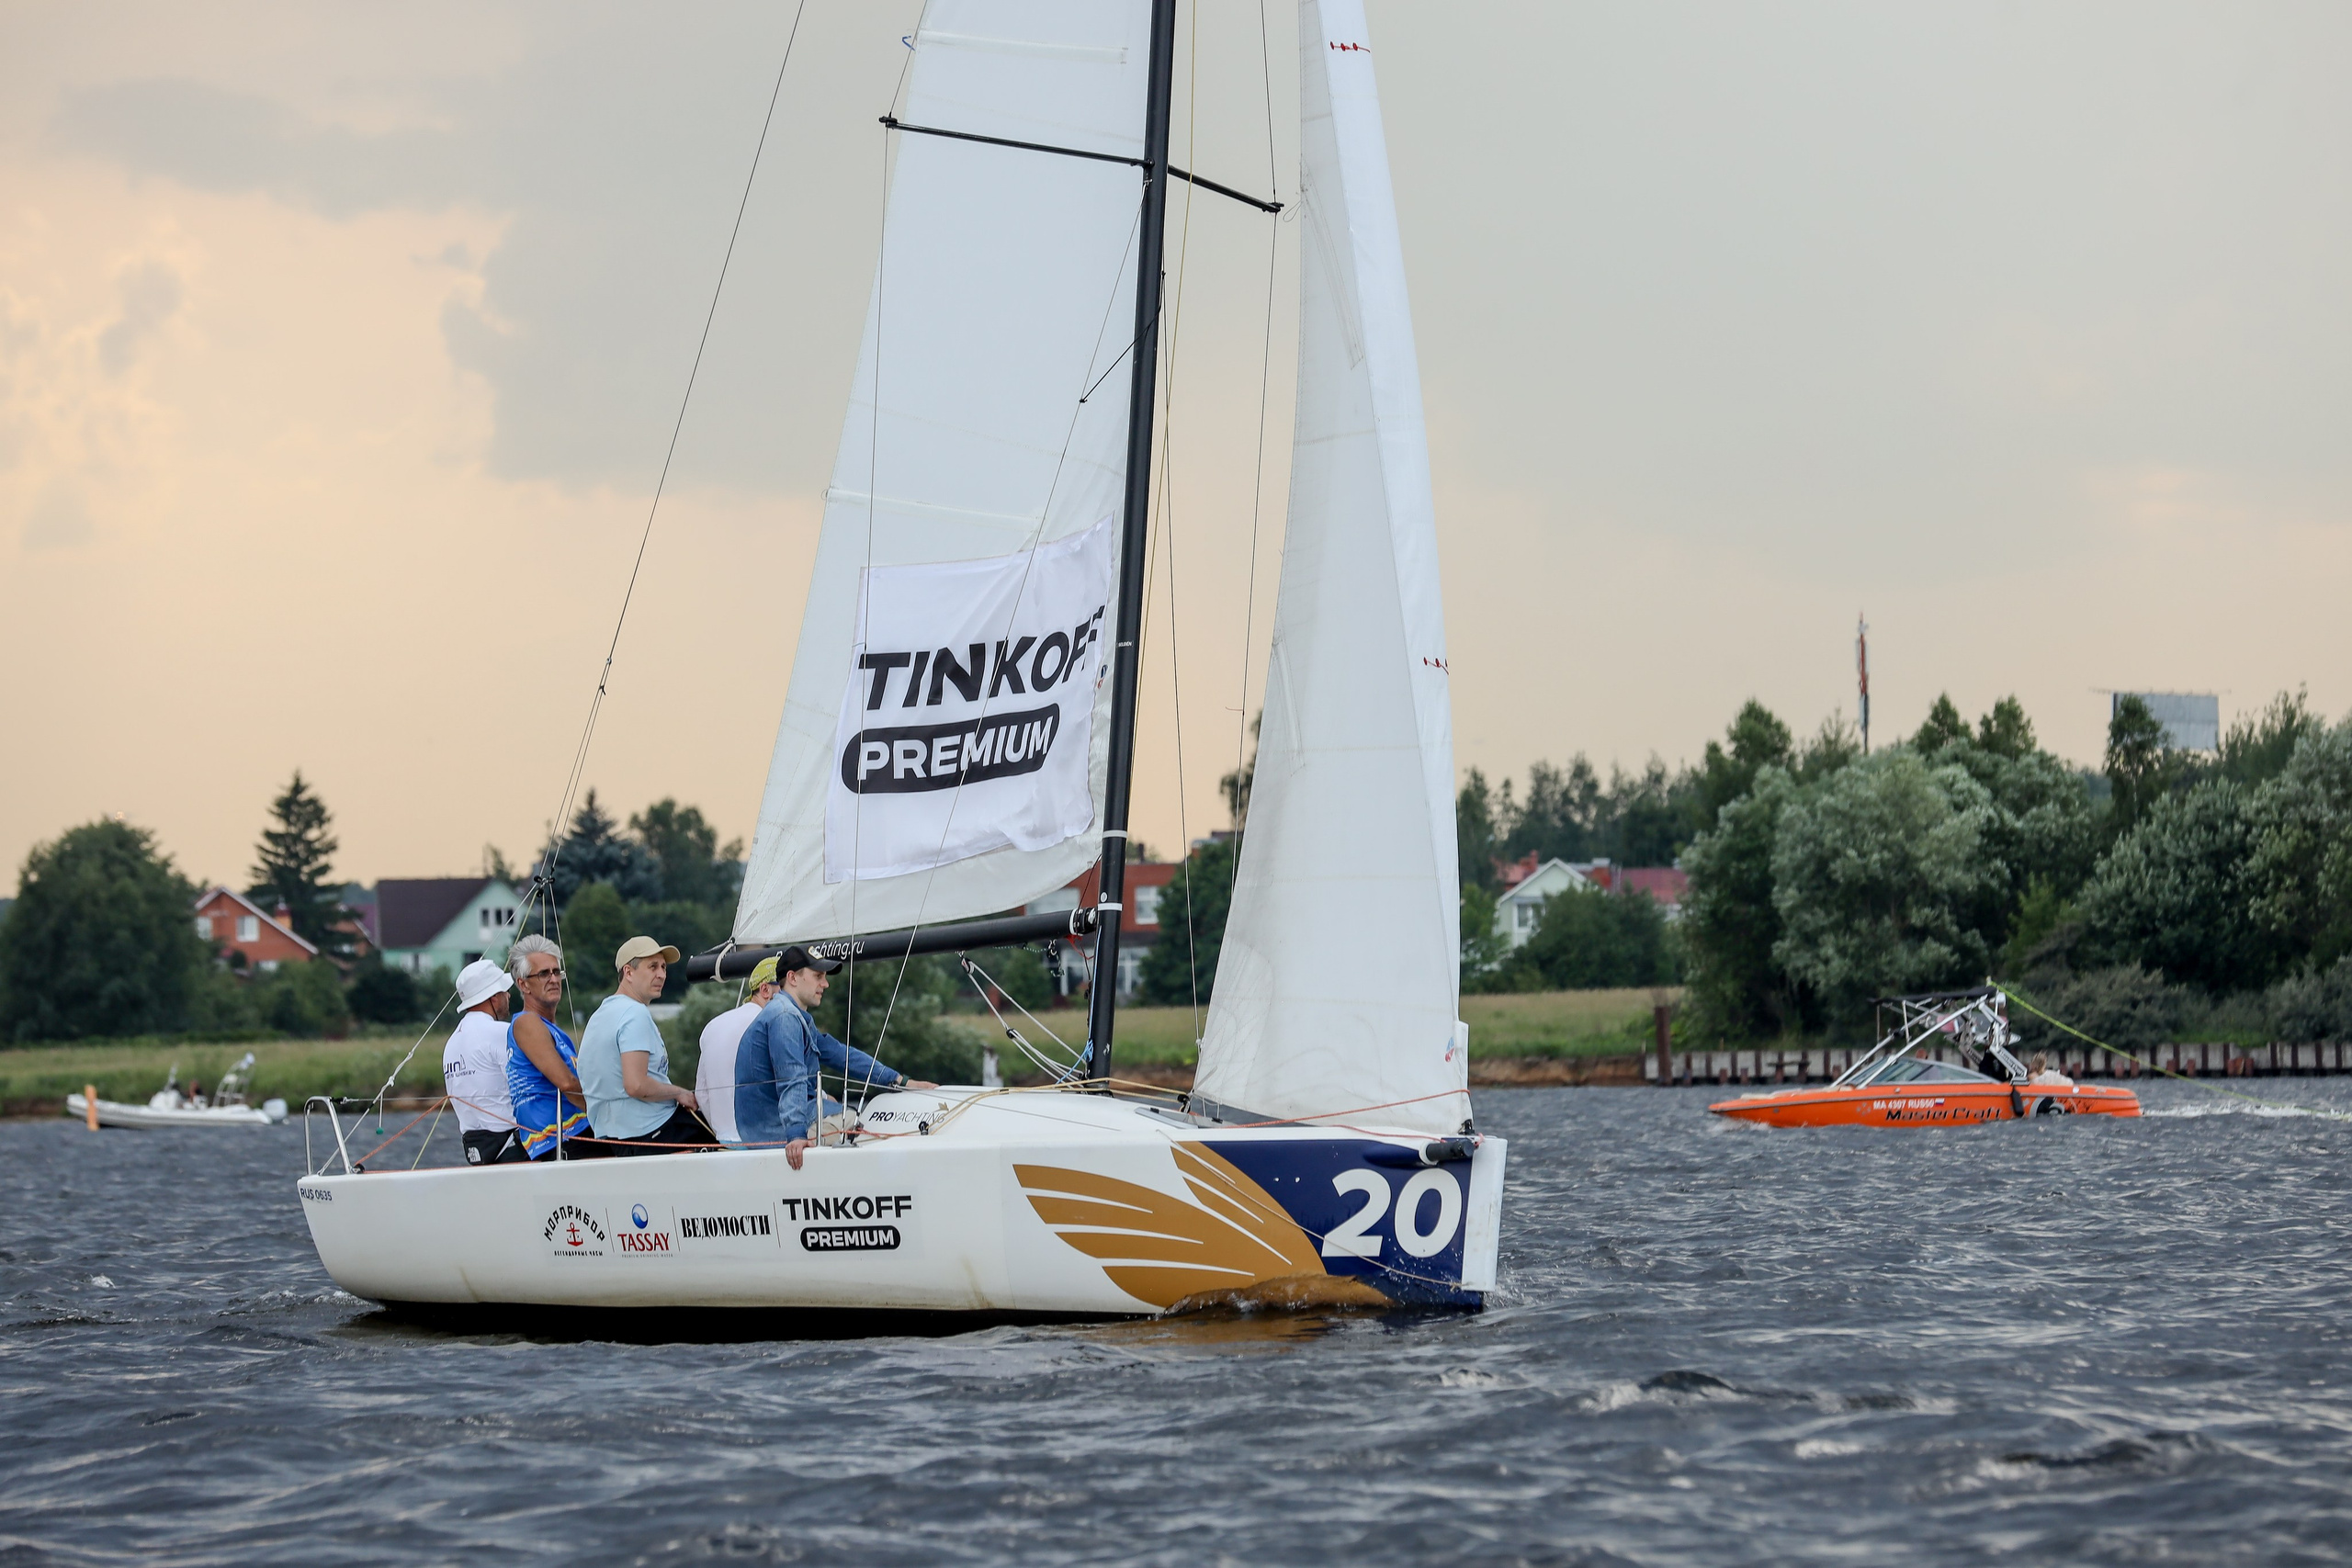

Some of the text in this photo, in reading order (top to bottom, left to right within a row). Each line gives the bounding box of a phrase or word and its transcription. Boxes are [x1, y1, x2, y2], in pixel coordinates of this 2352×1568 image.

[857, 716, 1054, 781] PREMIUM
[868, 1111, 945, 1123] PROYACHTING
[300, 1188, 315, 1201] RUS
[782, 1195, 912, 1222] TINKOFF
[1321, 1168, 1463, 1258] 20
[544, 1204, 605, 1242] МОРПРИБОР
[680, 1214, 772, 1241] ВЕДОМОСТИ
[617, 1232, 671, 1252] TASSAY
[806, 1229, 895, 1247] PREMIUM
